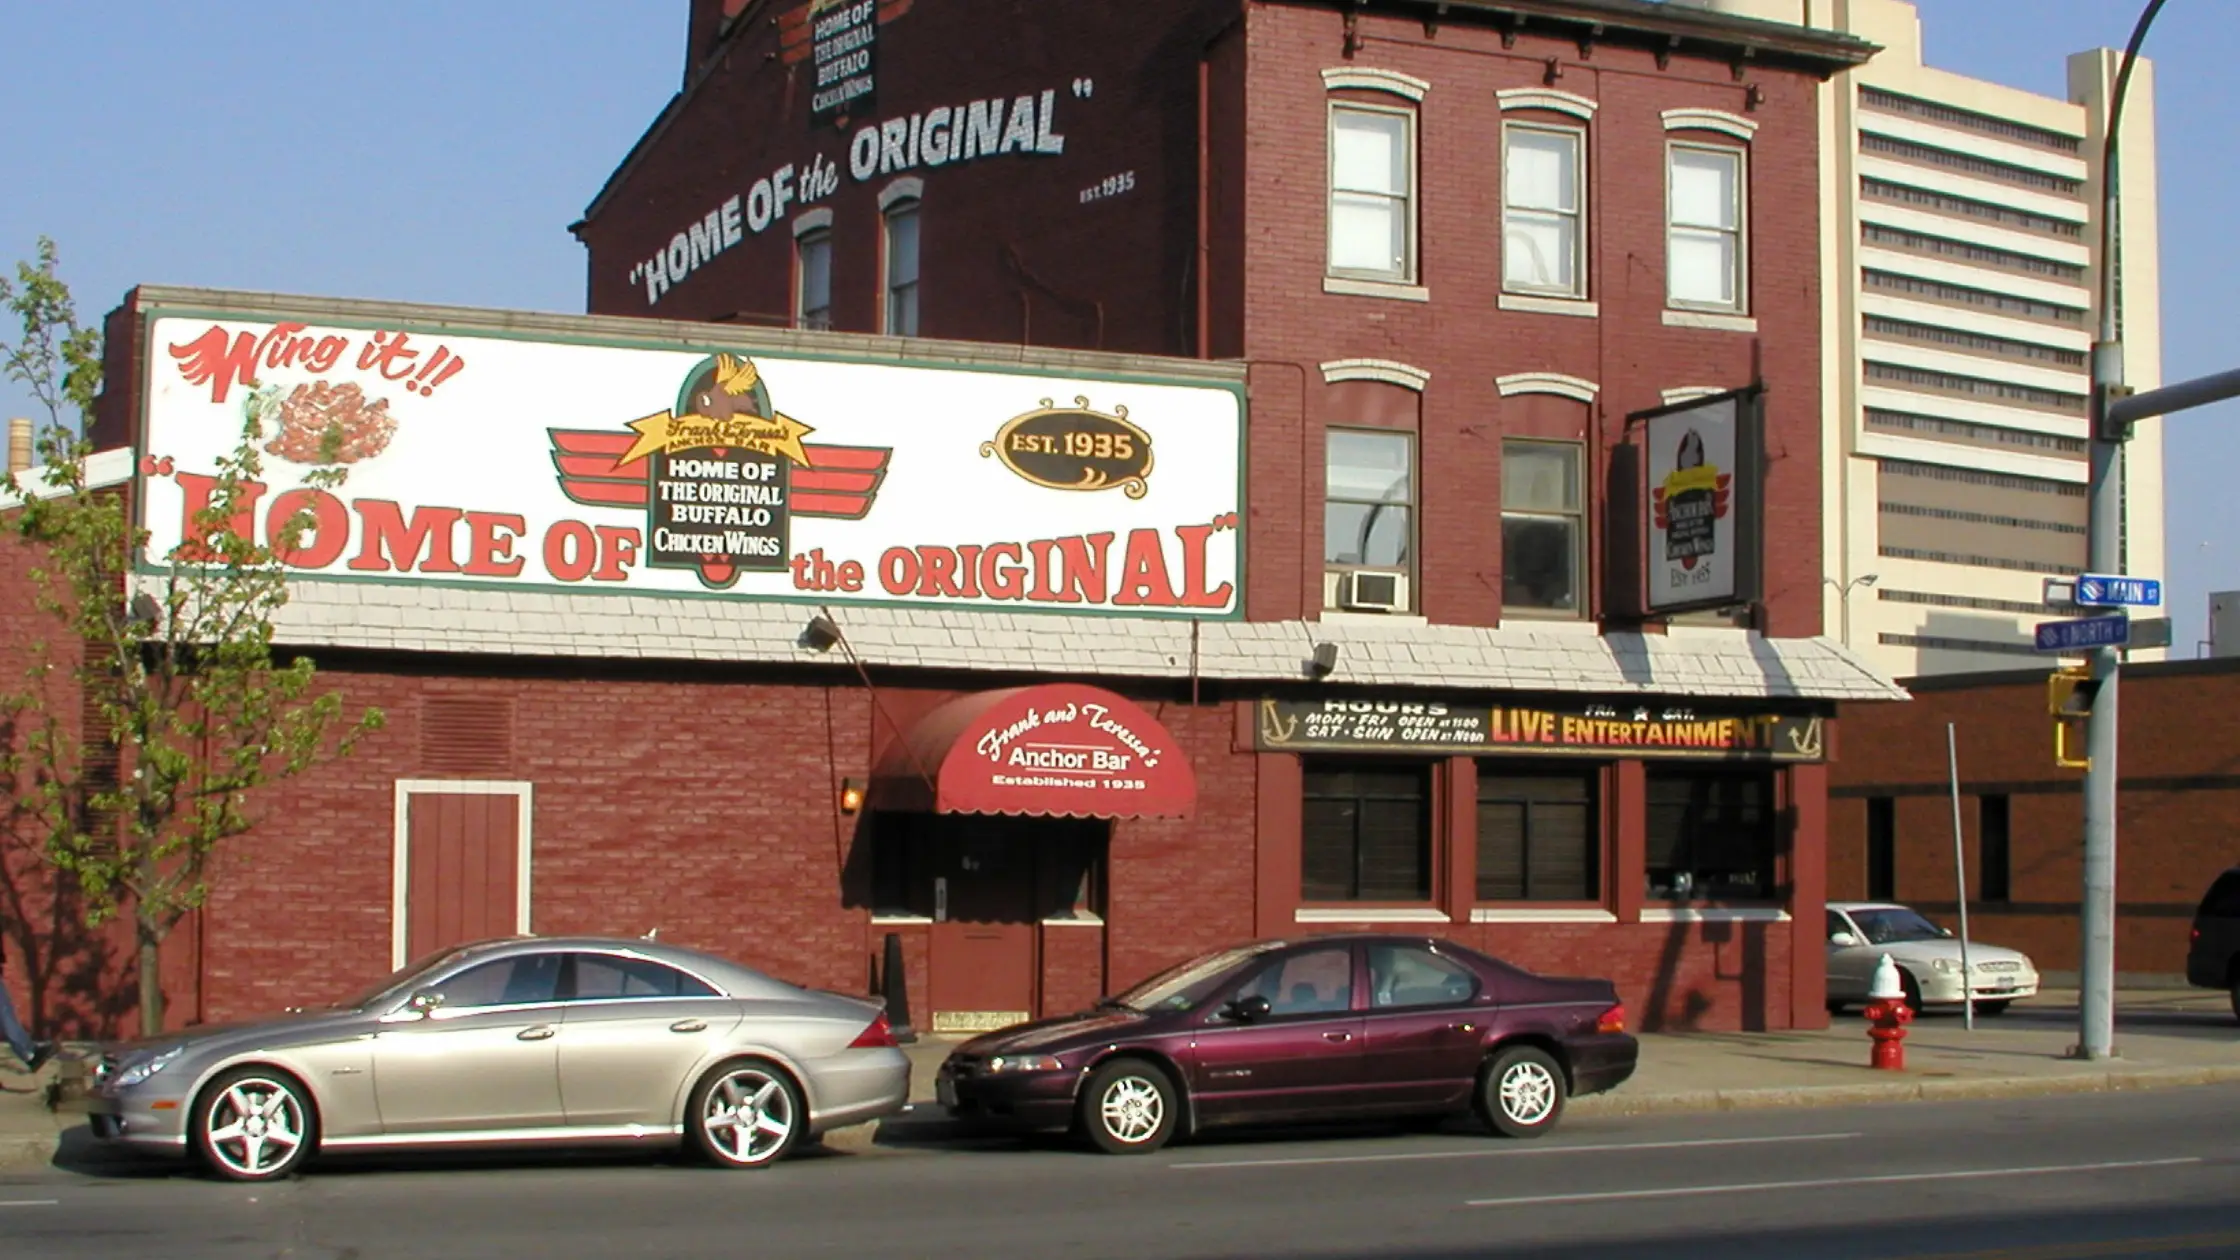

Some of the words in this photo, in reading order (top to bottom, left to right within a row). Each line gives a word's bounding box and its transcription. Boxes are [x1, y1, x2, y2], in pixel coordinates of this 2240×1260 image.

[815, 8, 851, 41] HOME
[852, 0, 874, 24] OF
[747, 163, 795, 232] OF
[800, 152, 839, 203] the
[1102, 169, 1135, 196] 1935
[168, 322, 349, 404] Wing
[1011, 433, 1059, 454] EST.
[1063, 431, 1134, 460] 1935
[668, 459, 739, 479] HOME
[741, 462, 776, 482] OF
[658, 481, 698, 501] THE
[698, 483, 783, 505] ORIGINAL
[671, 504, 771, 526] BUFFALO
[543, 519, 642, 581] OF
[789, 548, 863, 592] the
[2107, 580, 2144, 602] MAIN
[1305, 712, 1347, 725] MON
[1358, 713, 1389, 726] FRI
[1399, 716, 1436, 728] OPEN
[1324, 700, 1448, 716] HOURS
[976, 708, 1041, 762] Frank
[1044, 703, 1077, 724] and
[1081, 703, 1161, 768] Teressa's
[1306, 725, 1341, 738] SAT
[1352, 726, 1395, 741] SUN
[1401, 728, 1440, 741] OPEN
[1491, 705, 1556, 743] LIVE
[1562, 715, 1776, 748] ENTERTAINMENT
[1008, 747, 1088, 769] Anchor
[1092, 750, 1132, 770] Bar
[992, 774, 1097, 789] Established
[1103, 778, 1146, 790] 1935
